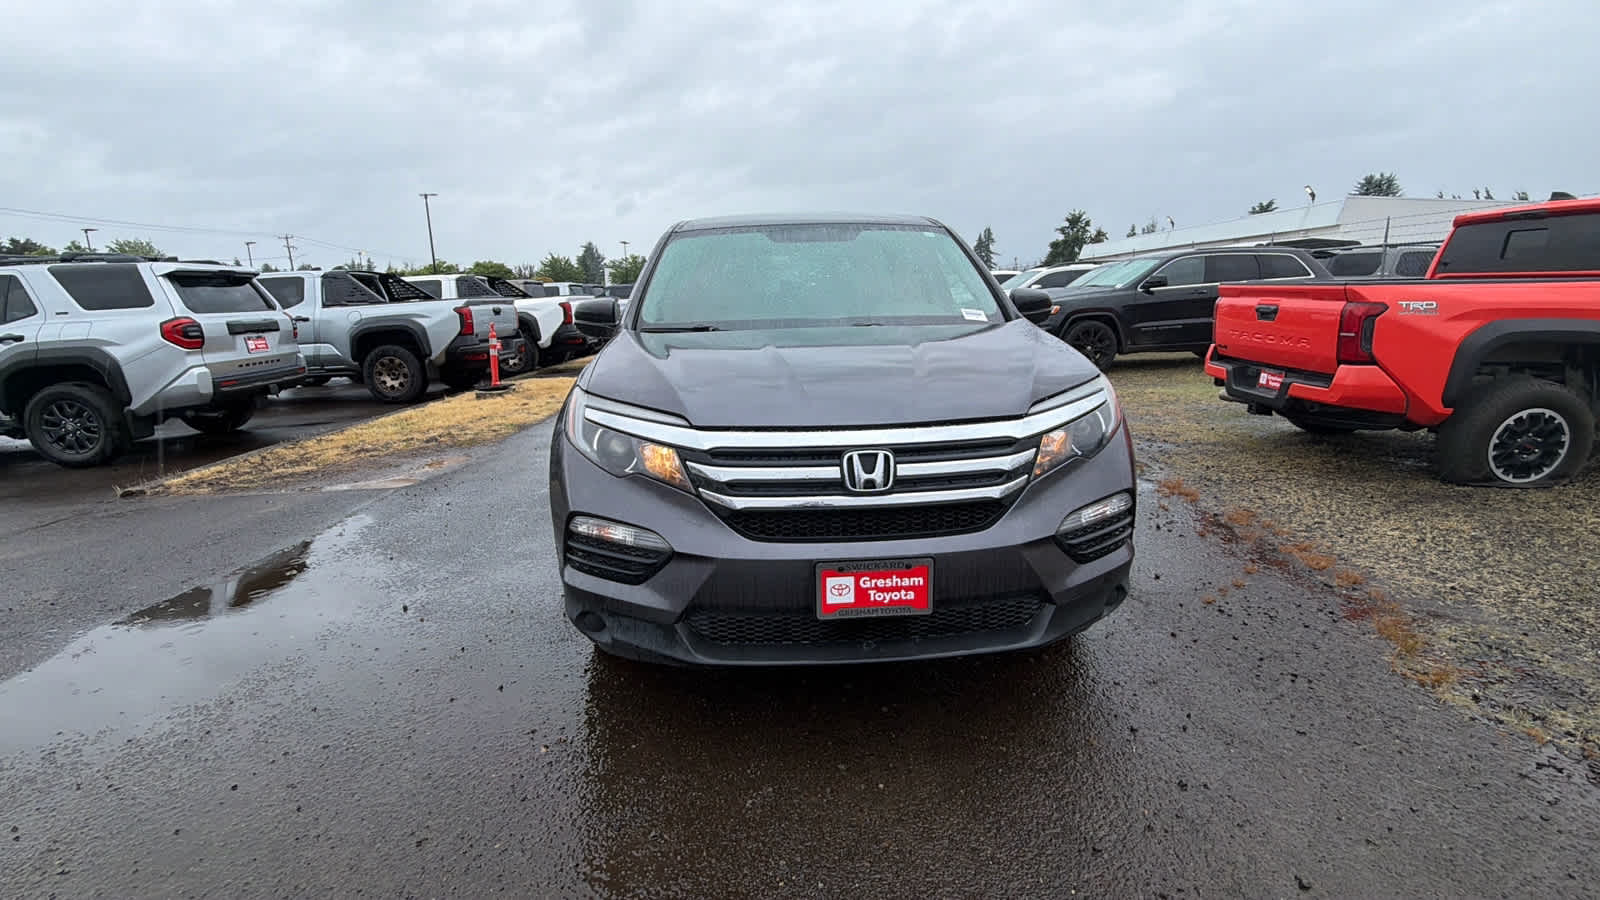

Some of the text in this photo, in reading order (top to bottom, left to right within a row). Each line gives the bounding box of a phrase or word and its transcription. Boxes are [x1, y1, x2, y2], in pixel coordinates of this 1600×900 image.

[1397, 300, 1437, 311] TRD
[1228, 328, 1312, 349] TACOMA
[846, 561, 905, 571] SWICKARD
[859, 575, 924, 588] Gresham
[867, 589, 915, 603] Toyota
[838, 606, 912, 617] GRESHAM TOYOTA
